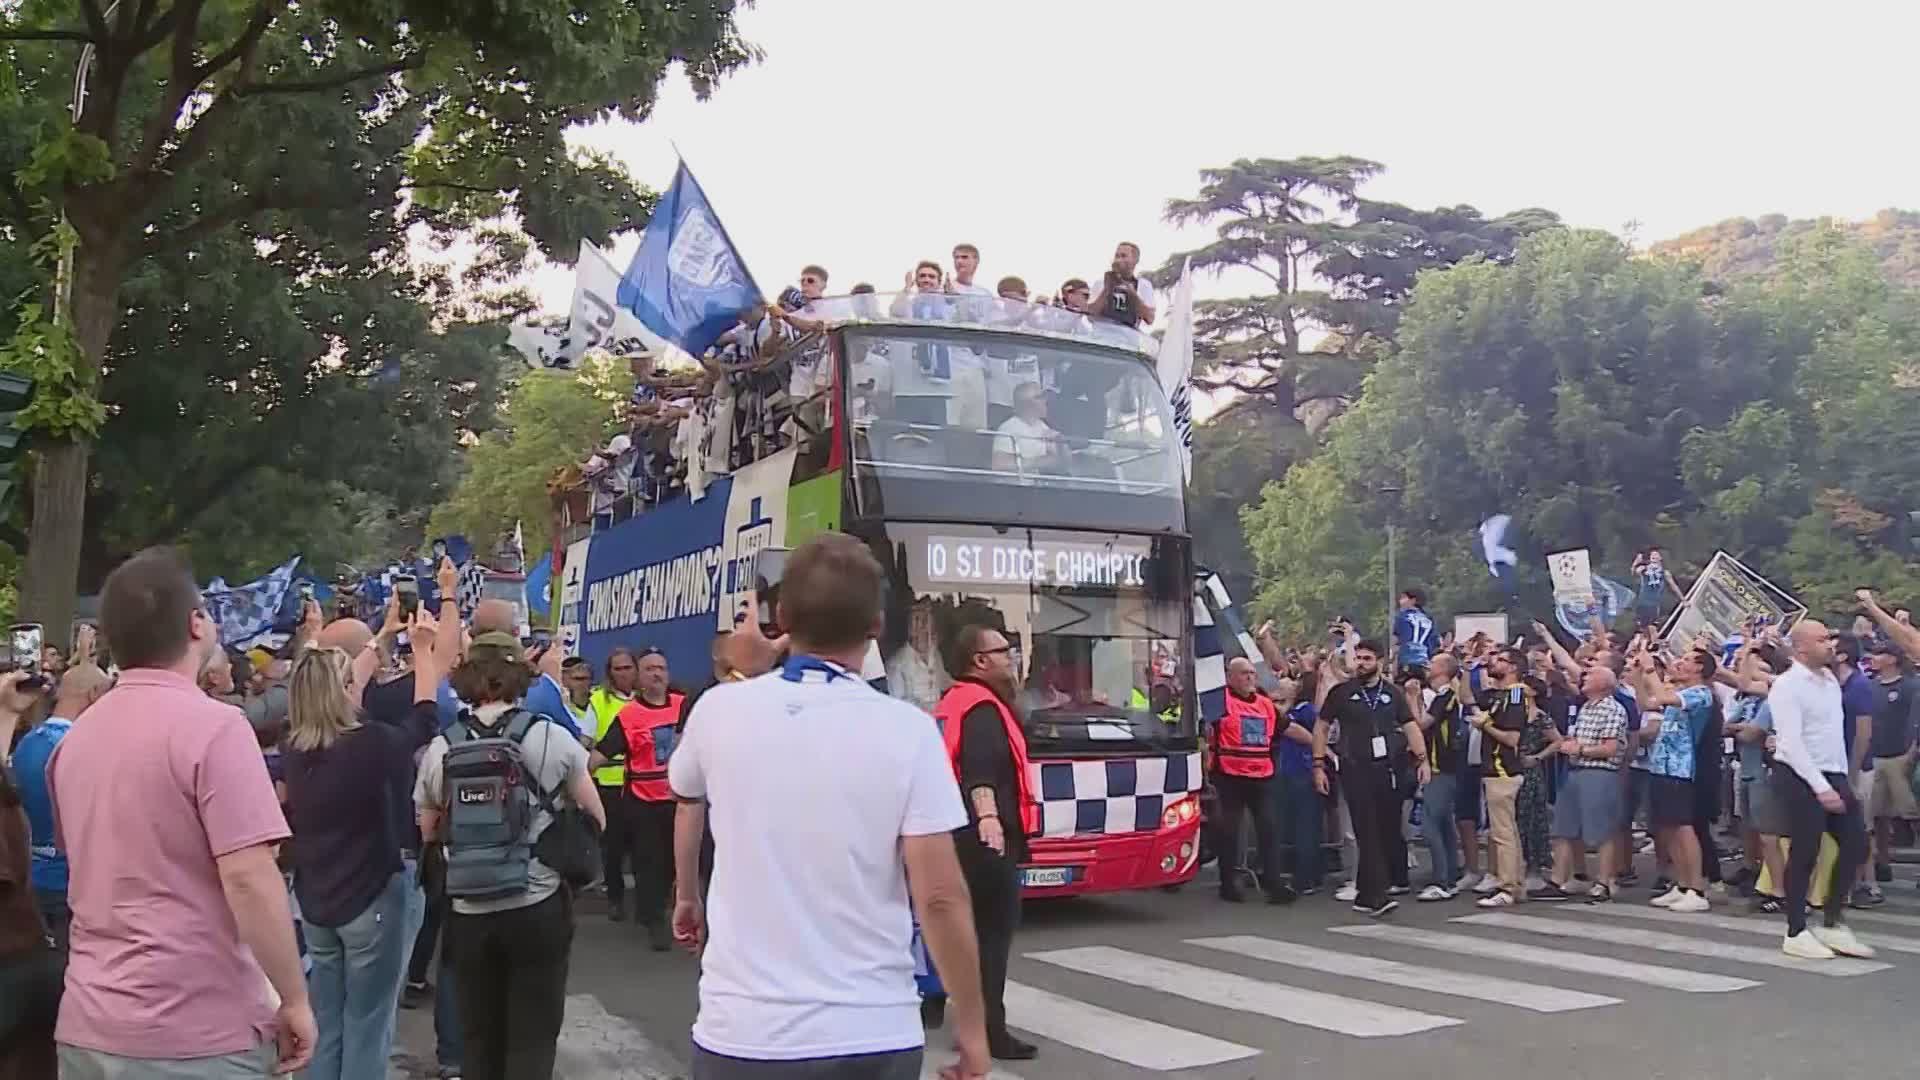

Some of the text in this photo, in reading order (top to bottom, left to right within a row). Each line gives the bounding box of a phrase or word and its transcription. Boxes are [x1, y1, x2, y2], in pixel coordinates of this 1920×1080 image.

[928, 543, 946, 577] O
[957, 544, 983, 578] SI
[992, 547, 1047, 581] DICE
[461, 788, 492, 802] LiveU
